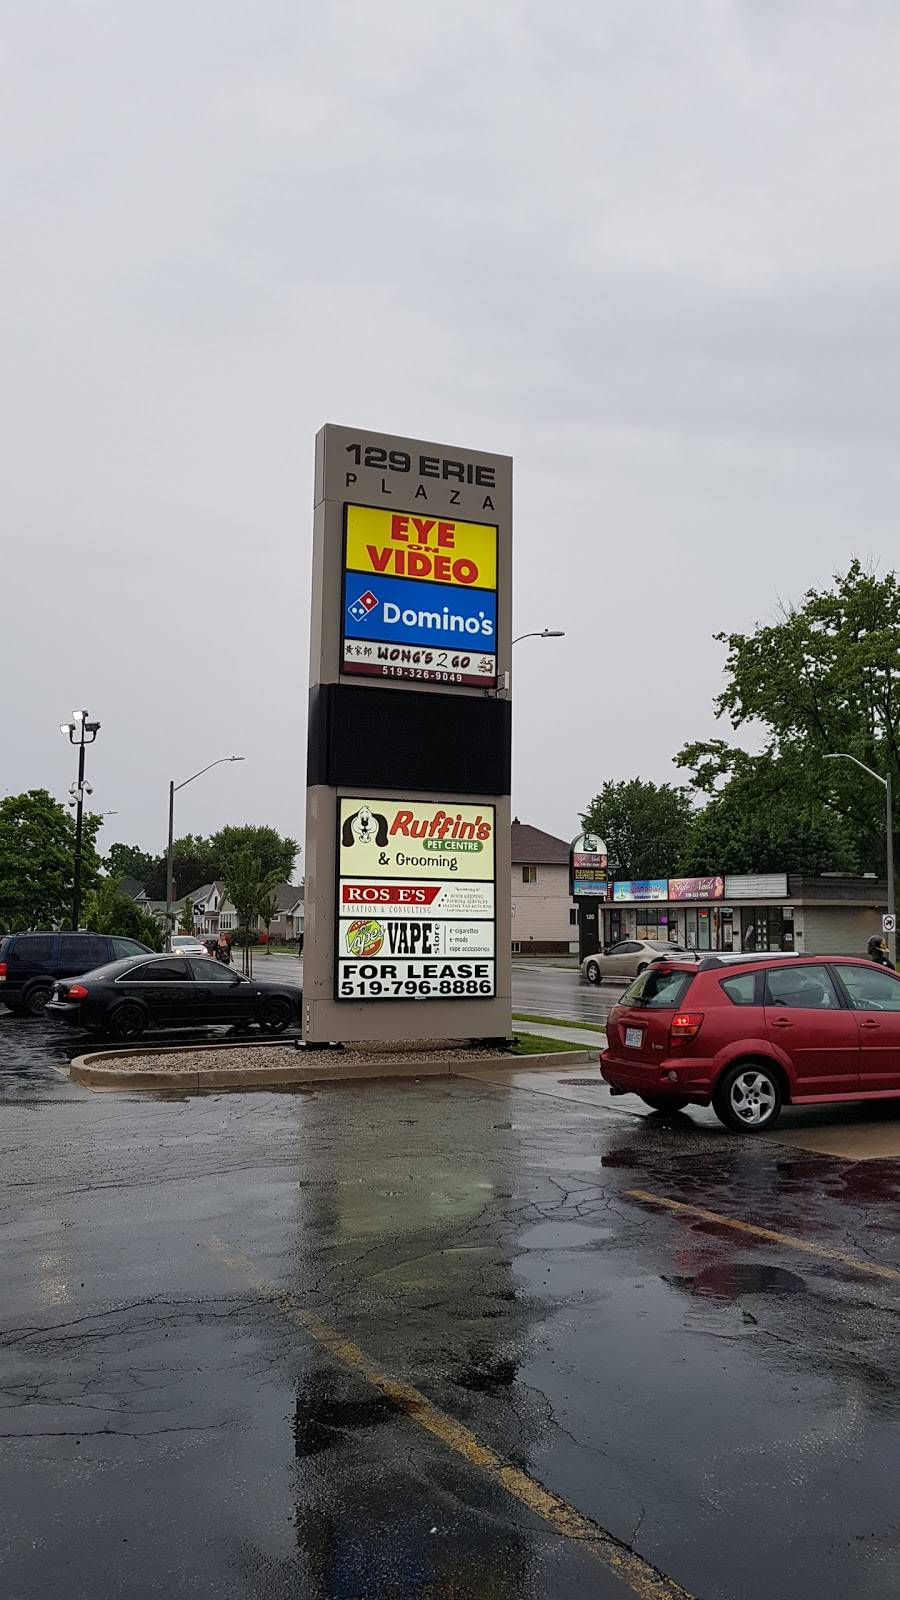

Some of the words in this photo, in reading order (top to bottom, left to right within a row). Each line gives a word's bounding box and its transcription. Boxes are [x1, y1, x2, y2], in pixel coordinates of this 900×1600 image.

[346, 443, 411, 473] 129
[419, 456, 496, 487] ERIE
[391, 514, 456, 549] EYE
[407, 544, 439, 553] ON
[366, 544, 479, 584] VIDEO
[383, 603, 494, 636] Domino's
[377, 647, 434, 665] WONG'S
[436, 652, 448, 668] 2
[451, 655, 471, 669] GO
[382, 666, 463, 682] 519-326-9049
[389, 810, 492, 841] Ruffin's
[427, 839, 443, 850] PET
[444, 840, 478, 851] CENTRE
[378, 853, 390, 866] &
[395, 852, 458, 871] Grooming
[389, 906, 432, 914] CONSULTING
[387, 922, 432, 954] VAPE
[433, 923, 441, 954] store
[343, 964, 397, 979] FOR
[407, 964, 489, 979] LEASE
[341, 980, 492, 996] 519-796-8886
